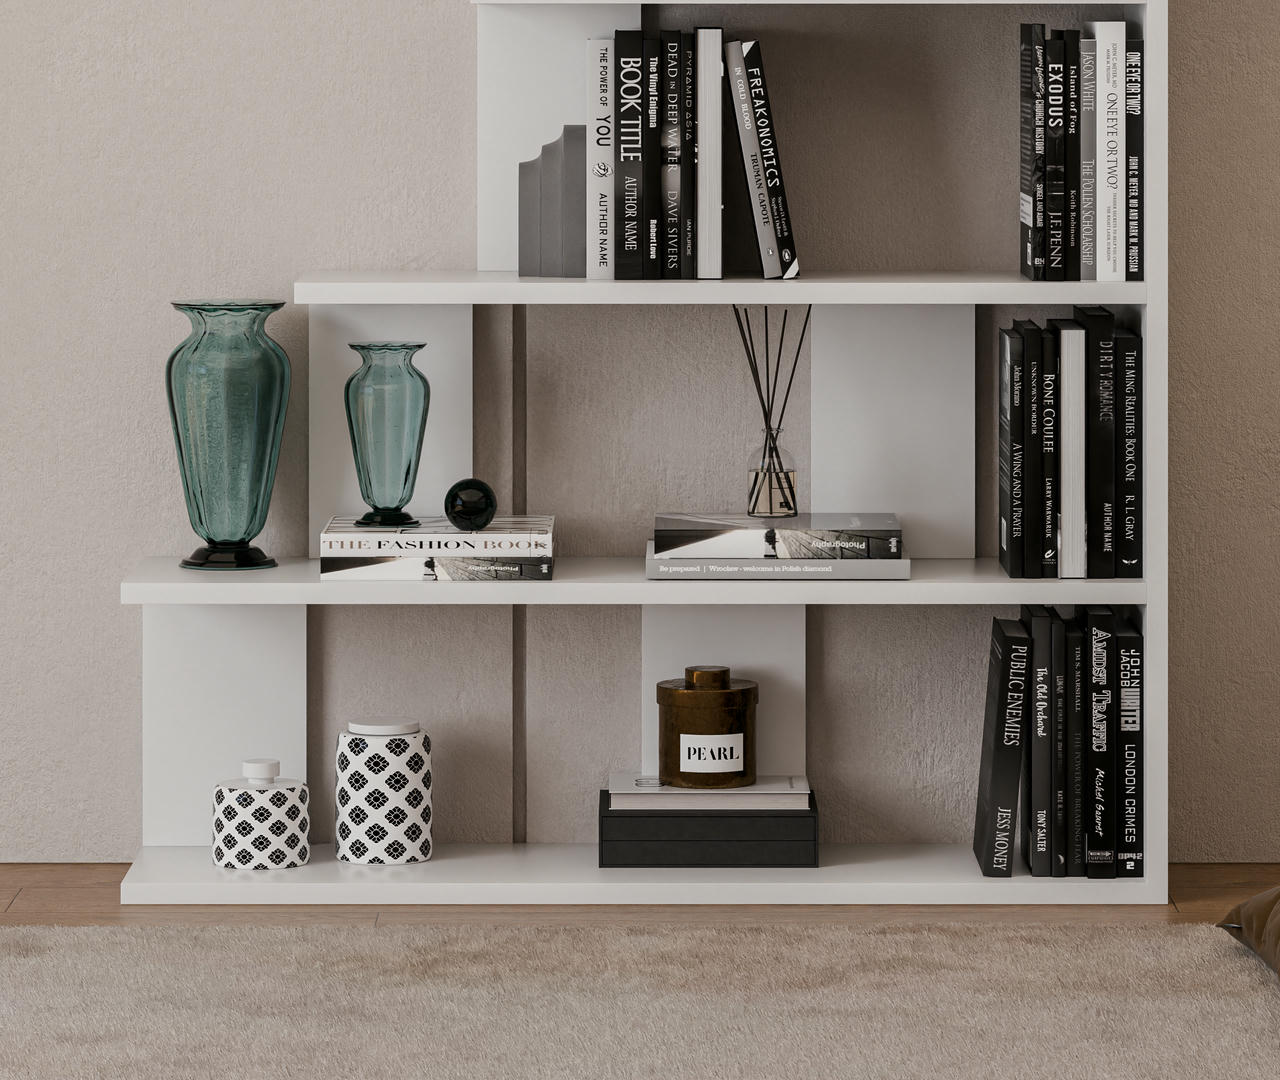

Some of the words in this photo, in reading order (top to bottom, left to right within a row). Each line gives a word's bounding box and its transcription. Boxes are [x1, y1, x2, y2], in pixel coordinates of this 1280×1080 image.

[599, 47, 608, 63] THE
[649, 56, 658, 73] The
[667, 42, 678, 78] DEAD
[1081, 51, 1096, 79] JASON
[1126, 51, 1141, 67] ONE
[599, 65, 608, 94] POWER
[620, 57, 642, 112] BOOK
[648, 73, 658, 95] Vinyl
[685, 50, 693, 108] PYRAMID
[734, 66, 742, 75] IN
[1069, 65, 1077, 98] Island
[1126, 68, 1141, 82] EYE
[599, 96, 608, 107] OF
[736, 79, 746, 100] COLD
[1048, 63, 1063, 127] EXODUS
[1082, 81, 1096, 112] WHITE
[1126, 83, 1141, 93] OR
[648, 96, 658, 128] Enigma
[667, 93, 678, 125] DEEP
[741, 103, 751, 130] BLOOD
[1035, 99, 1044, 125] CHURCH
[1069, 101, 1077, 113] of
[1106, 92, 1118, 115] ONE
[1126, 94, 1141, 115] TWO?
[596, 115, 611, 147] YOU
[620, 115, 642, 161] TITLE
[685, 111, 693, 141] ASIA
[747, 67, 780, 188] FREAKONOMICS
[1068, 115, 1077, 134] Fog
[1106, 118, 1118, 136] EYE
[667, 127, 678, 173] WATER
[1035, 127, 1044, 155] HISTORY
[1106, 140, 1118, 156] OR
[1082, 159, 1095, 176] THE
[1106, 158, 1118, 189] TWO?
[1128, 156, 1139, 170] JOHN
[624, 176, 637, 218] AUTHOR
[750, 152, 764, 189] TRUMAN
[757, 193, 770, 227] CAPOTE
[1082, 178, 1095, 208] POLLEN
[1128, 178, 1139, 198] MEYER,
[599, 192, 607, 236] AUTHOR
[667, 191, 678, 223] DAVE
[1128, 199, 1139, 207] MD
[1128, 209, 1139, 220] AND
[649, 219, 657, 243] Robert
[1047, 212, 1062, 228] J.F.
[1128, 221, 1139, 236] MARK
[624, 221, 637, 251] NAME
[667, 227, 678, 269] SIVERS
[1050, 230, 1062, 268] PENN
[1082, 210, 1095, 266] SCHOLARSHIP
[599, 238, 607, 267] NAME
[649, 243, 657, 259] Love
[1128, 246, 1139, 273] PRUSSIAN
[1125, 350, 1136, 367] THE
[1013, 365, 1022, 381] John
[1125, 369, 1136, 393] MING
[1043, 374, 1055, 405] BONE
[1099, 379, 1113, 422] ROMANCE
[1125, 395, 1136, 436] REALITIES:
[1043, 408, 1055, 453] COULEE
[1013, 451, 1022, 477] WING
[1125, 438, 1136, 462] BOOK
[1125, 463, 1136, 481] ONE
[1013, 478, 1022, 498] AND
[1045, 477, 1053, 498] LARRY
[1125, 495, 1135, 504] R.
[1013, 507, 1022, 538] PRAYER
[1045, 500, 1053, 538] WARWARUK
[1103, 503, 1112, 531] AUTHOR
[1125, 516, 1135, 540] GRAY
[322, 540, 371, 549] THE
[377, 540, 475, 549] FASHION
[483, 540, 547, 549] BOOK
[811, 540, 866, 549] Photography
[1103, 533, 1112, 552] NAME
[1008, 645, 1028, 689] PUBLIC
[1092, 627, 1111, 685] AMIDST
[1120, 649, 1130, 687] JACOB
[1130, 649, 1140, 687] JOHN
[1036, 667, 1048, 682] The
[1036, 684, 1048, 700] Old
[1003, 692, 1024, 746] ENEMIES
[1035, 701, 1048, 738] Orchard
[1092, 689, 1111, 752] TRAFFIC
[1120, 688, 1140, 731] WRITER
[687, 746, 739, 761] PEARL
[1125, 744, 1136, 794] LONDON
[1095, 767, 1105, 801] Michel
[996, 807, 1011, 829] JESS
[1037, 809, 1046, 828] TONY
[1095, 803, 1105, 837] Sauret
[1125, 799, 1136, 843] CRIMES
[993, 831, 1009, 870] MONEY
[1037, 828, 1046, 852] SALTER
